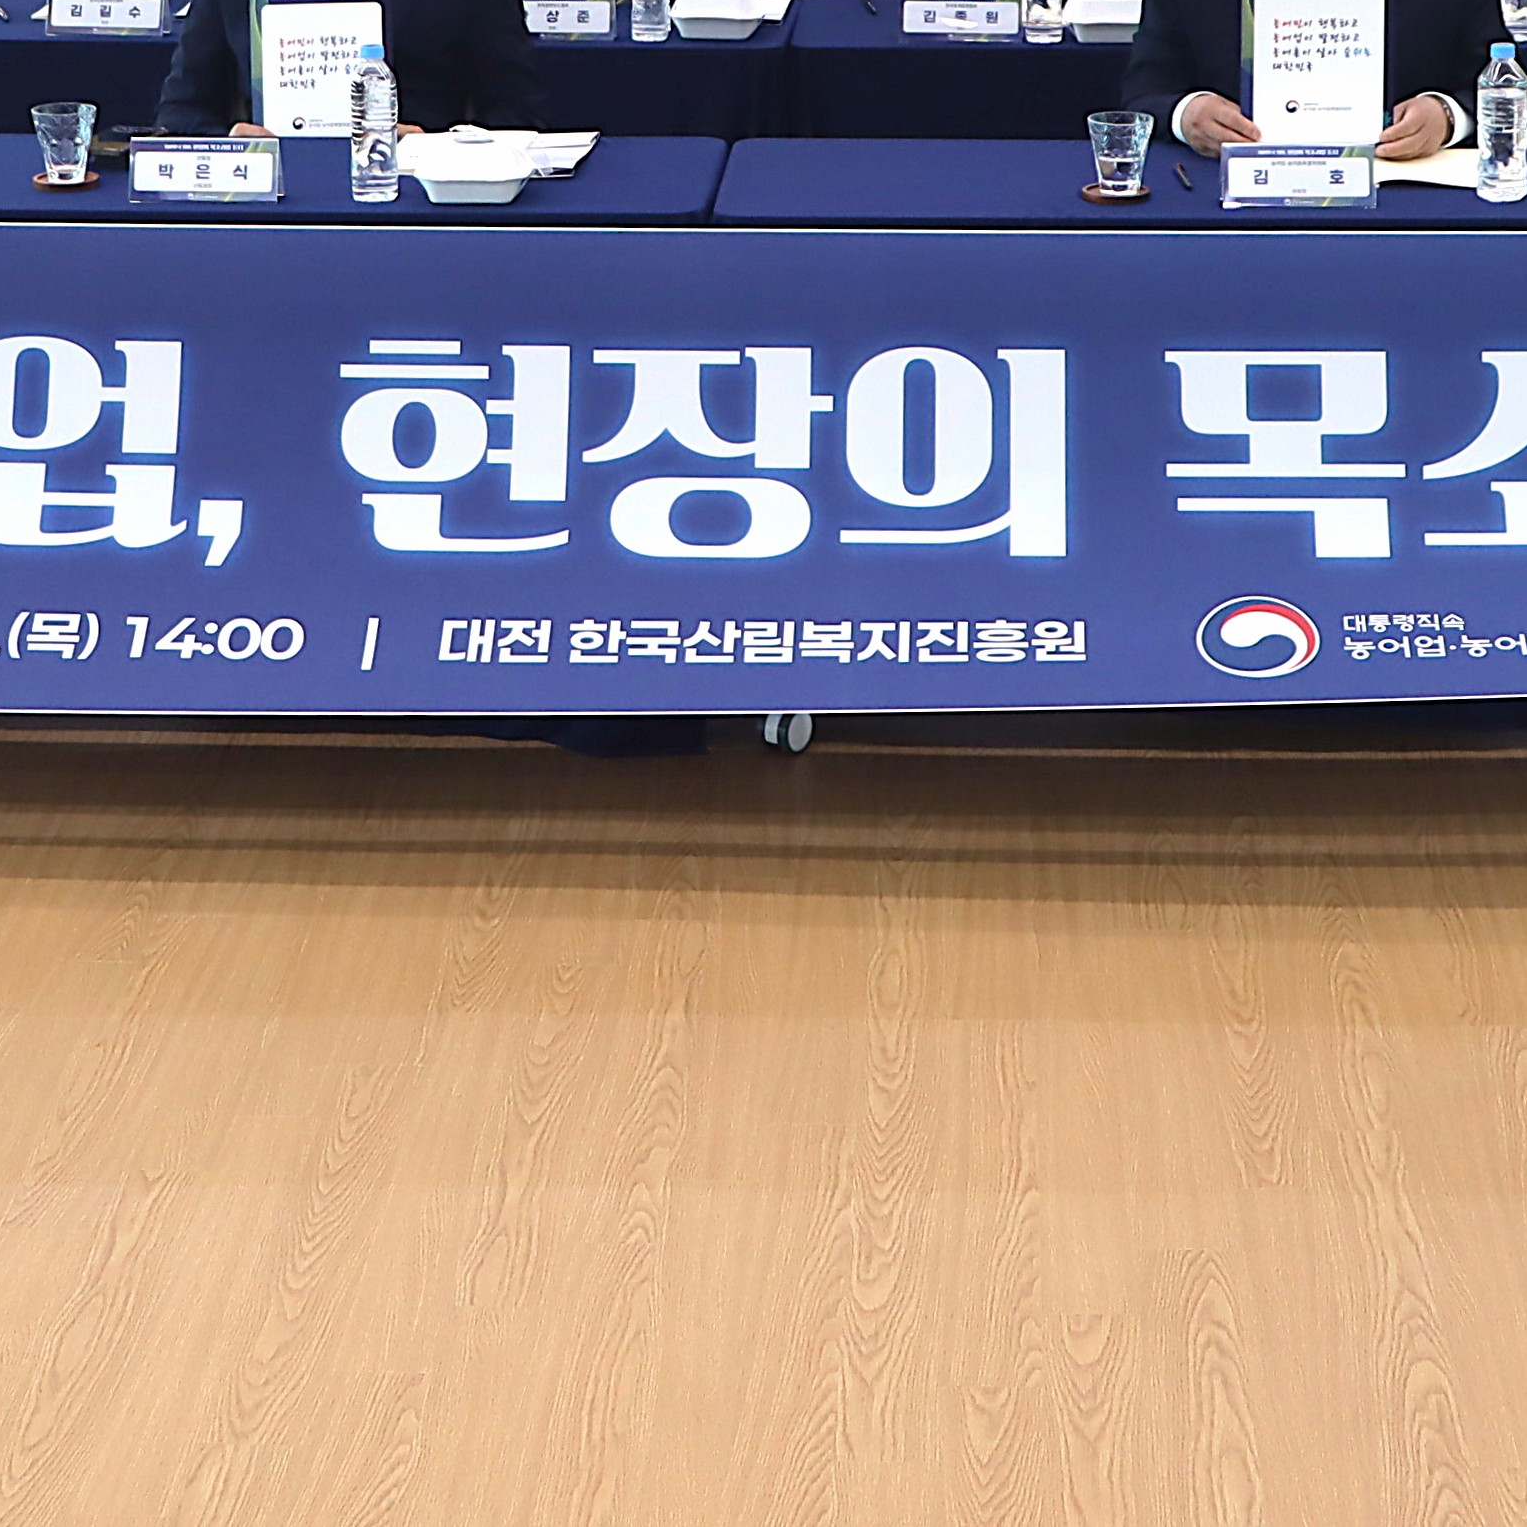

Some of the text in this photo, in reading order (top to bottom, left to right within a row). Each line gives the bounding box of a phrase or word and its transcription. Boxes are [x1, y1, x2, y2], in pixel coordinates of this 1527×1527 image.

[339, 340, 1067, 558] 현장의
[126, 616, 304, 660] 14:00
[438, 619, 552, 664] 대전
[569, 619, 1086, 664] 한국산림복지진흥원
[1342, 613, 1465, 633] 대통령직속
